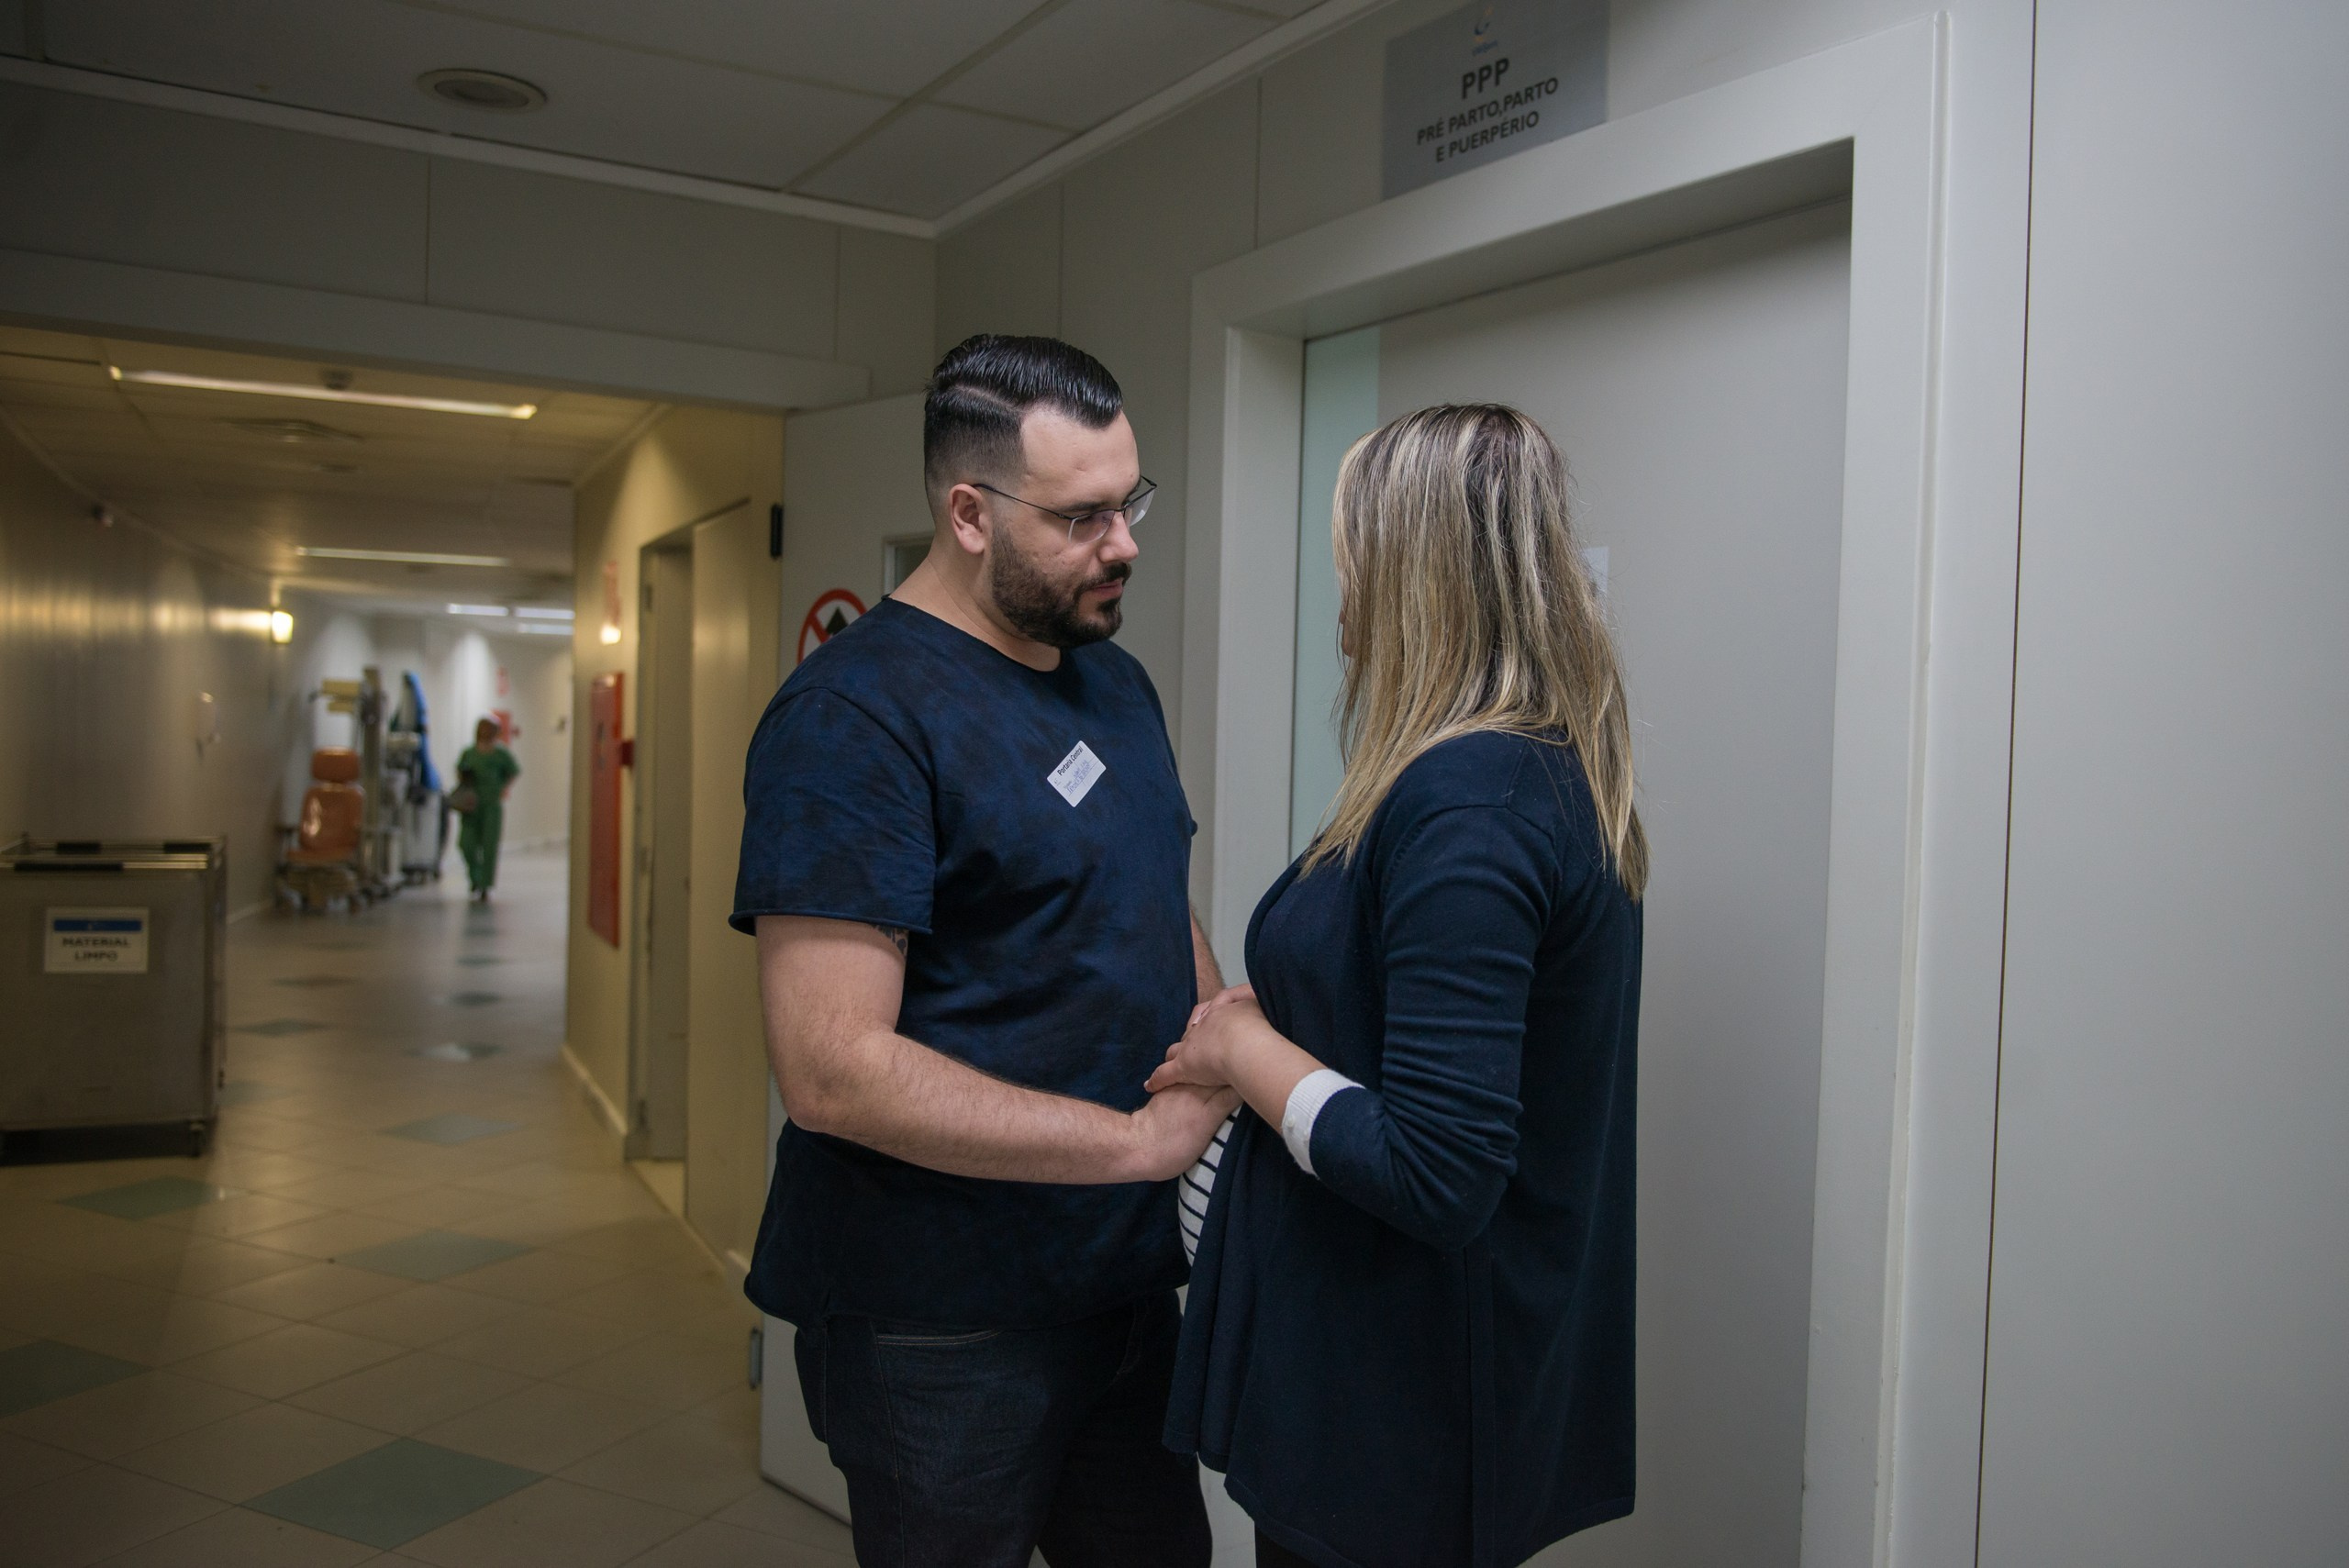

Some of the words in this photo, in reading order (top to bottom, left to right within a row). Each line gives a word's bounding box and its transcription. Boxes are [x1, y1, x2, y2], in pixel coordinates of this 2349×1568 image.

[1462, 58, 1510, 100] PPP
[1417, 117, 1444, 146] PRÉ
[1436, 146, 1445, 163] E
[1448, 110, 1541, 158] PUERPÉRIO
[1057, 759, 1074, 776] Portaria
[1070, 745, 1085, 762] Central
[62, 937, 129, 948] MATERIAL
[74, 951, 117, 962] LIMPO
